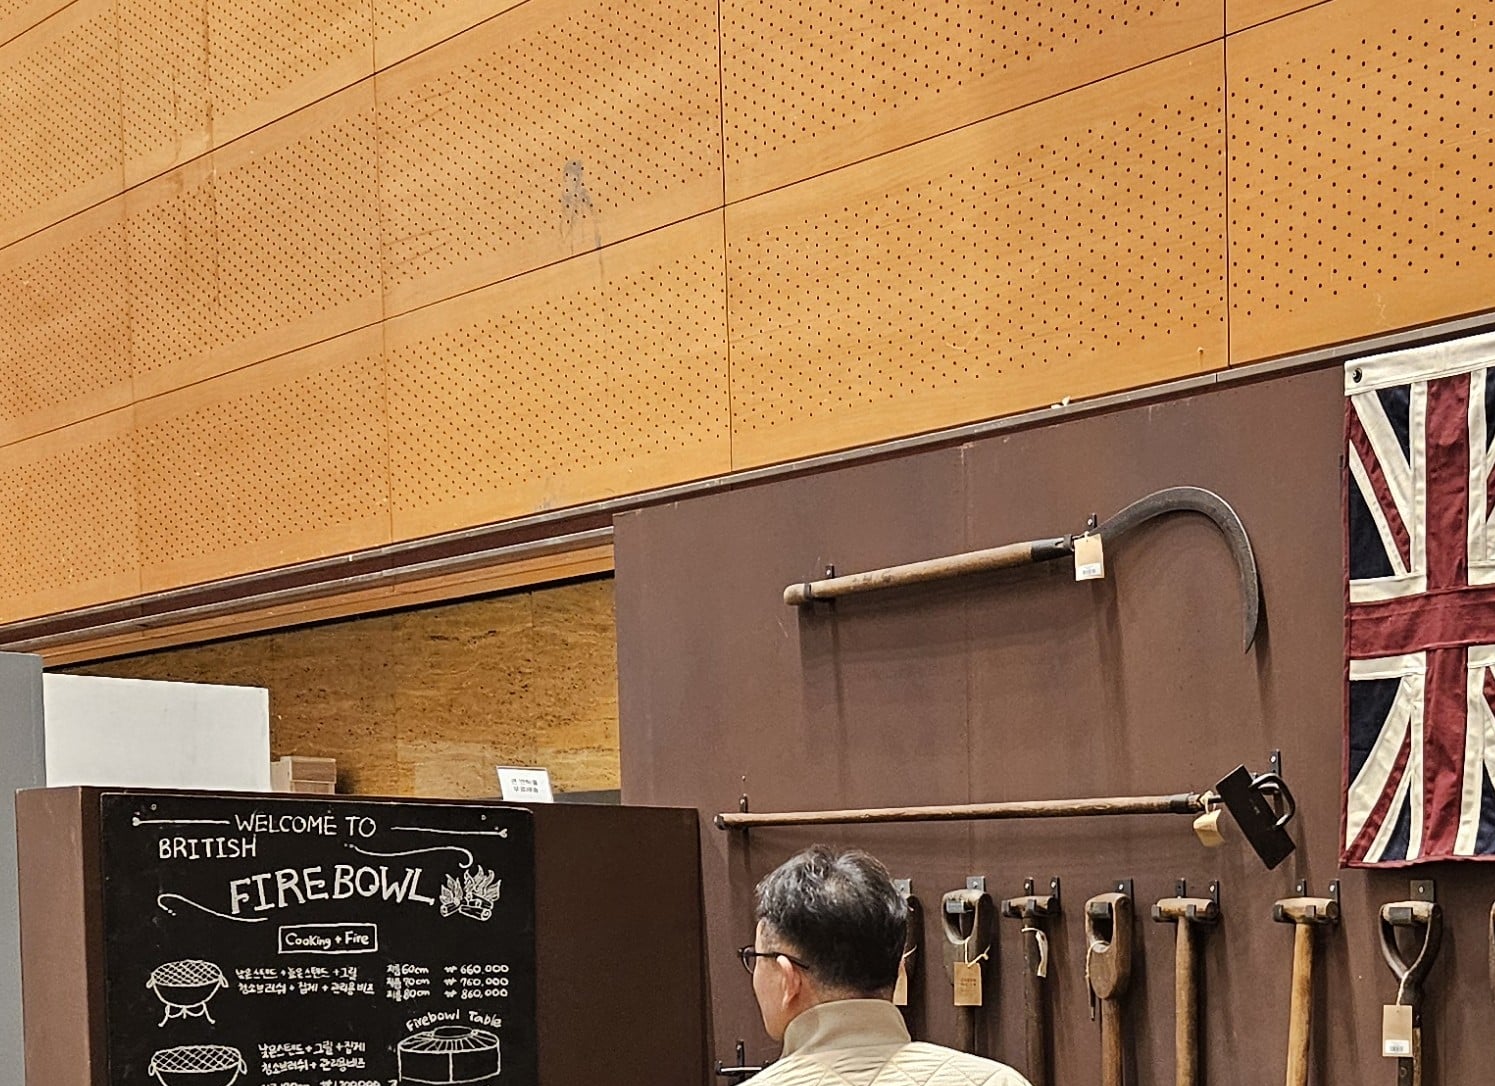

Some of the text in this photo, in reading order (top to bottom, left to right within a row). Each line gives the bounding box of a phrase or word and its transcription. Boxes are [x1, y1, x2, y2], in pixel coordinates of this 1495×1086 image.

[234, 811, 377, 838] WELCOME TO
[158, 834, 257, 860] BRITISH
[229, 864, 435, 914] FIREBOWL
[345, 930, 369, 945] Fire
[406, 1009, 502, 1032] Firebowl Table
